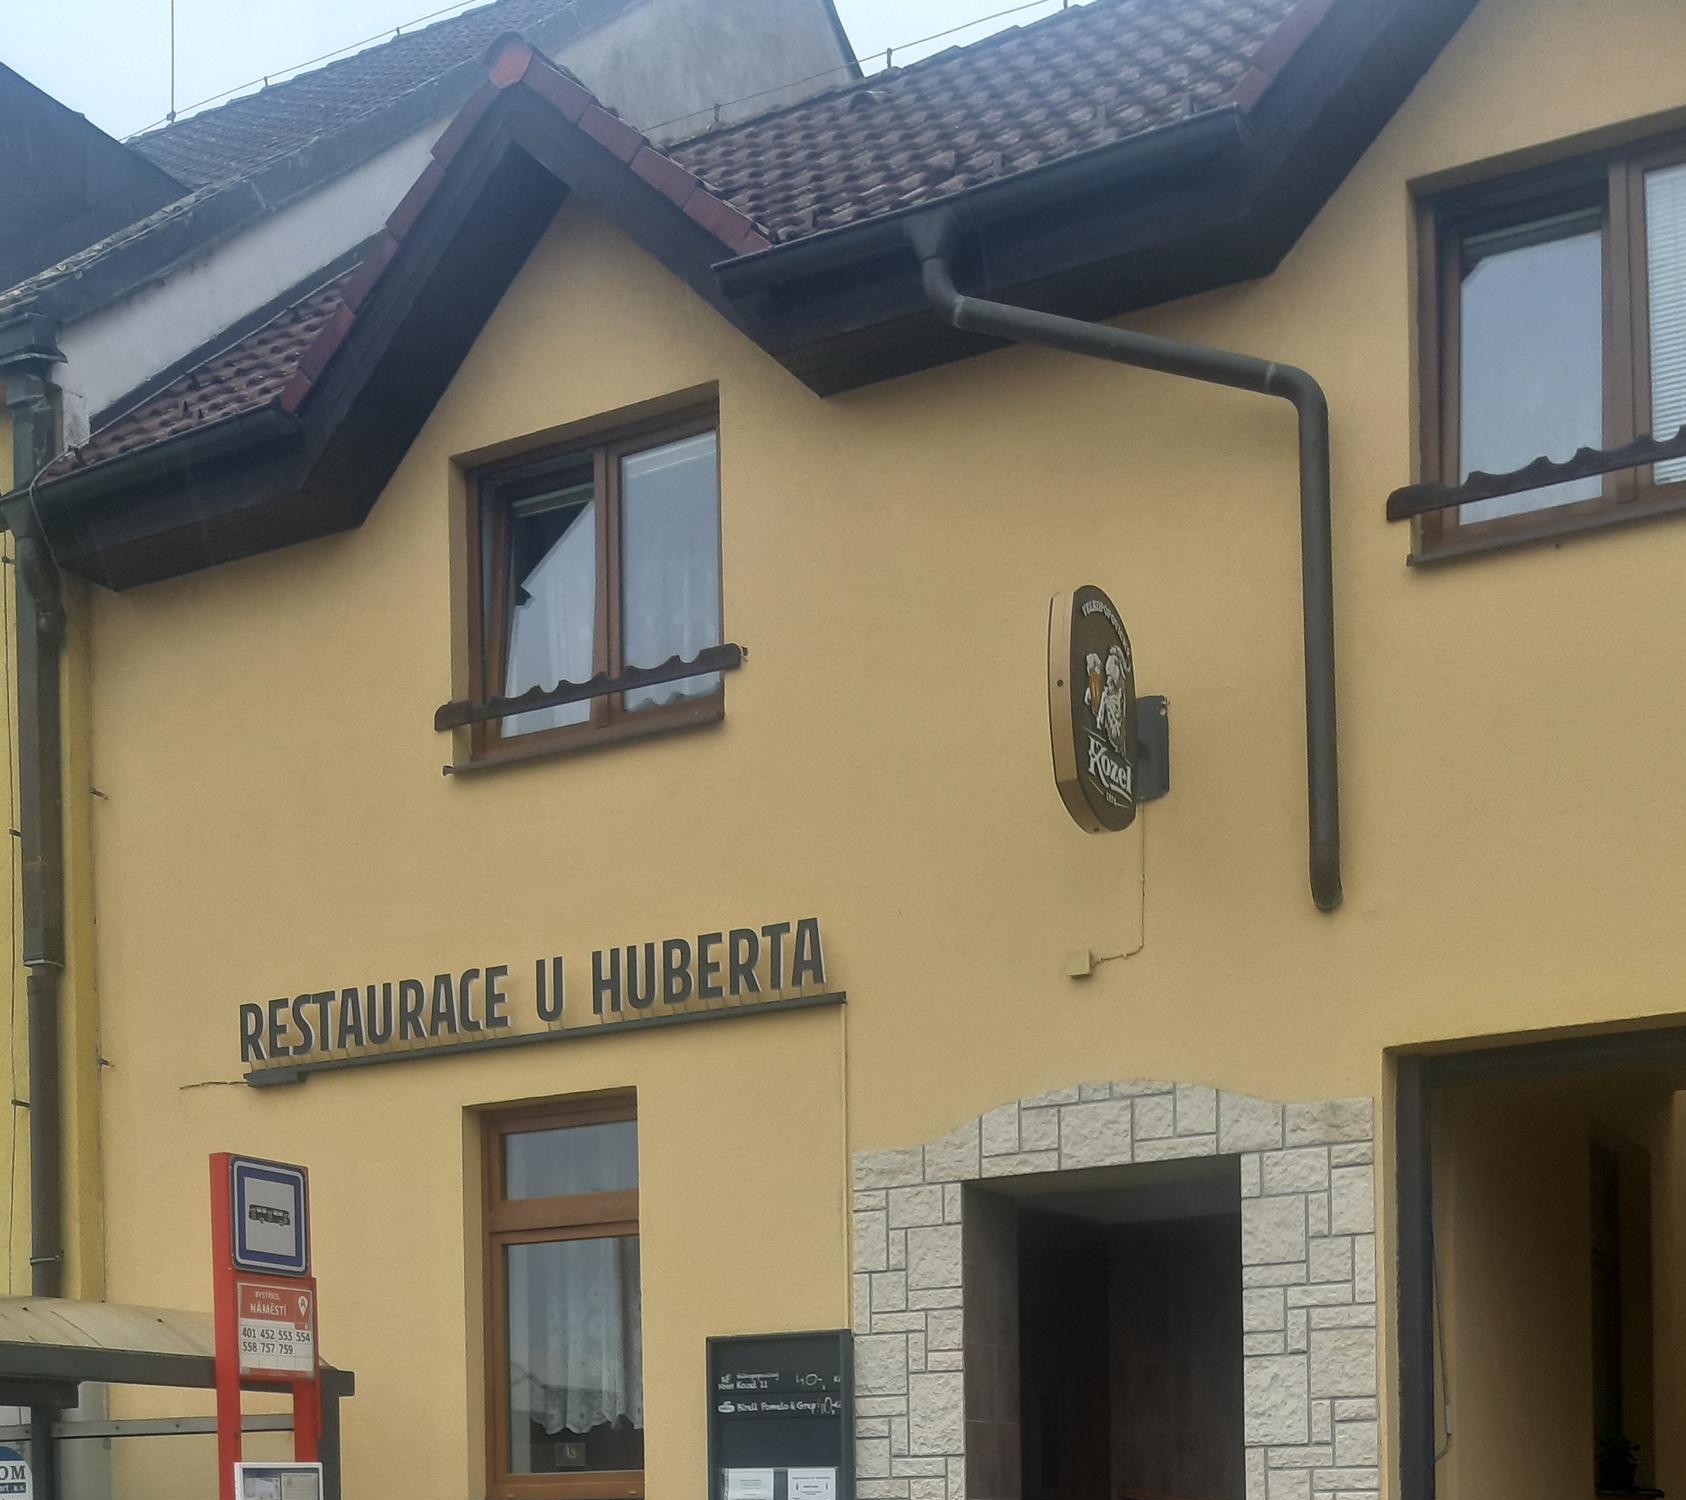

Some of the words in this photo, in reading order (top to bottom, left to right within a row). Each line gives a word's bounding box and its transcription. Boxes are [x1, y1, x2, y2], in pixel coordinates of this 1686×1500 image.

[1087, 734, 1132, 795] Kozel
[240, 964, 509, 1062] RESTAURACE
[535, 956, 564, 1021] U
[591, 917, 826, 1015] HUBERTA
[250, 1301, 287, 1317] NÁMĚSTÍ
[242, 1327, 256, 1339] 401
[260, 1329, 275, 1341] 452
[278, 1331, 293, 1342] 553
[296, 1332, 311, 1343] 554
[242, 1342, 257, 1353] 558
[261, 1343, 275, 1354] 757
[279, 1344, 294, 1355] 759
